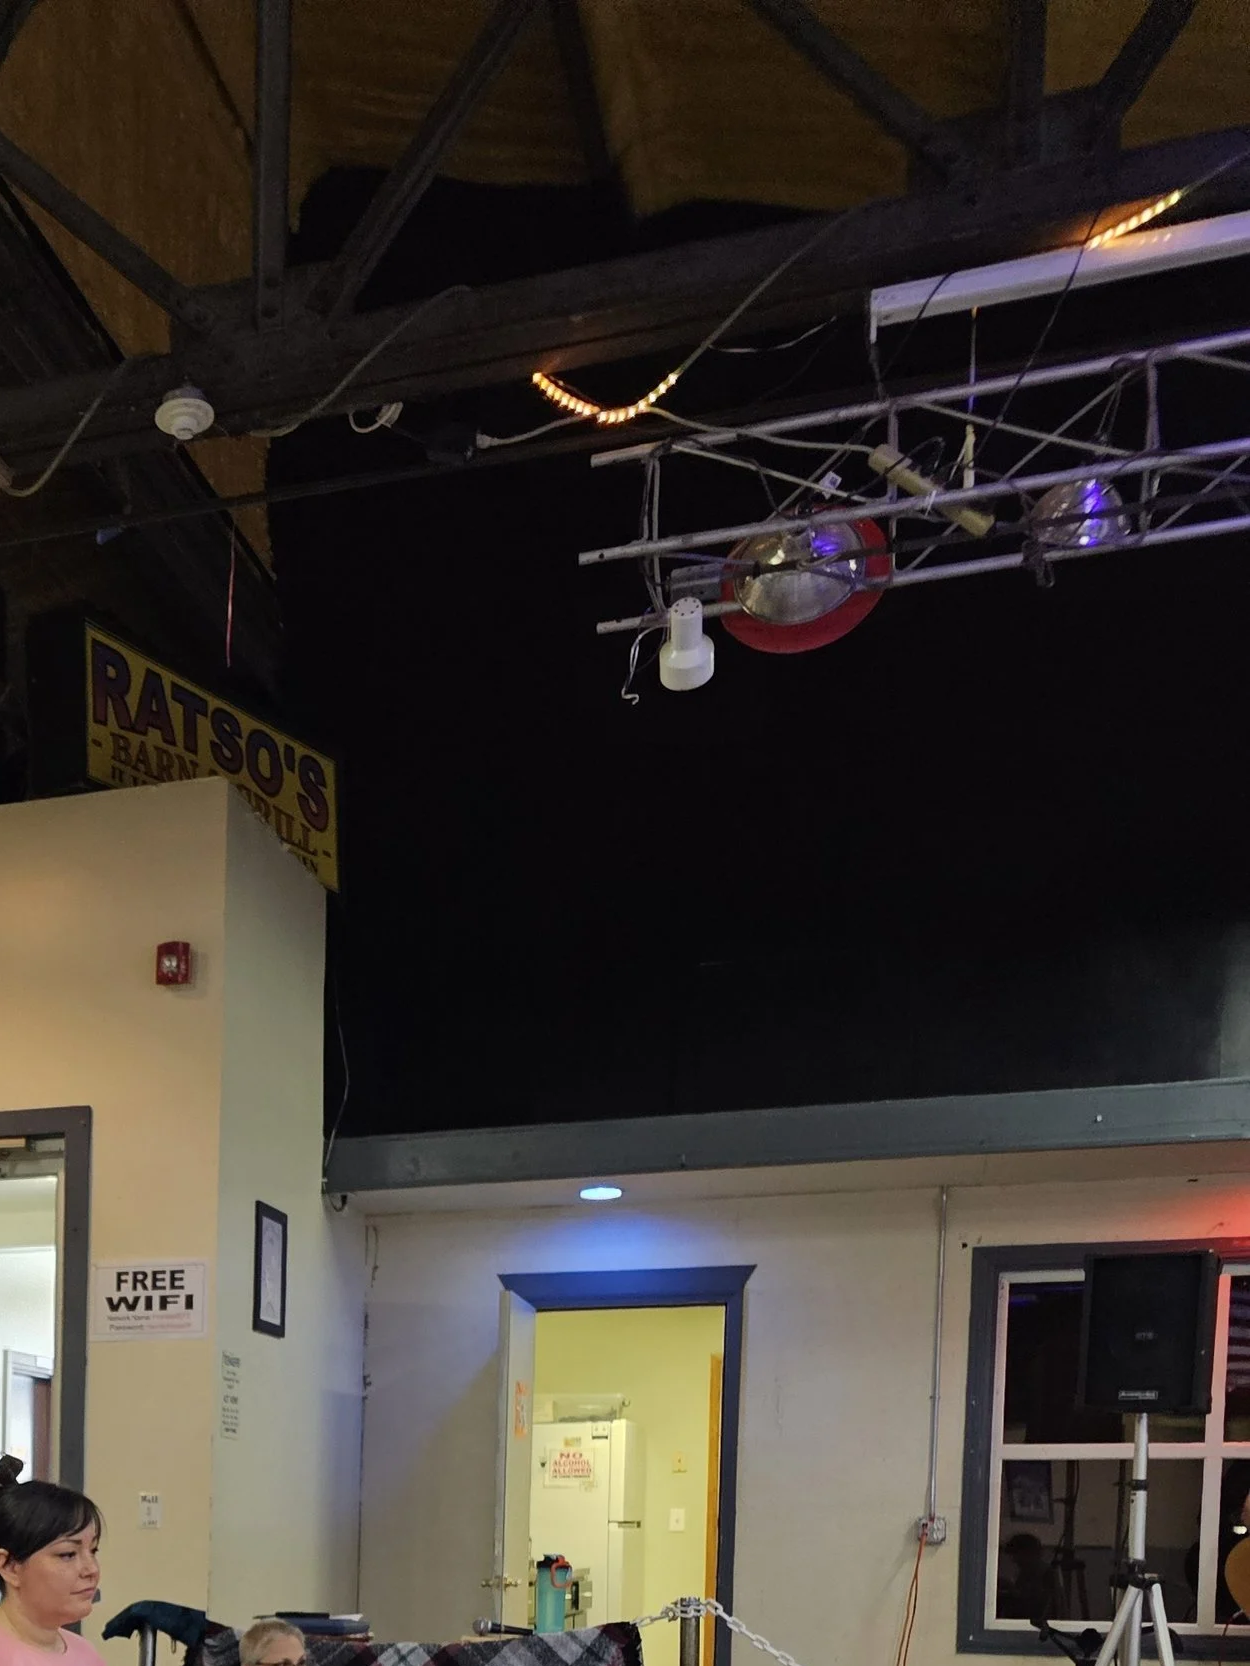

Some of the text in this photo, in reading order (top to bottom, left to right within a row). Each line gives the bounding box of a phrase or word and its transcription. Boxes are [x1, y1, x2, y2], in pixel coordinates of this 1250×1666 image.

[91, 638, 330, 833] RATSO'S
[116, 1269, 185, 1292] FREE
[105, 1294, 194, 1313] WIFI
